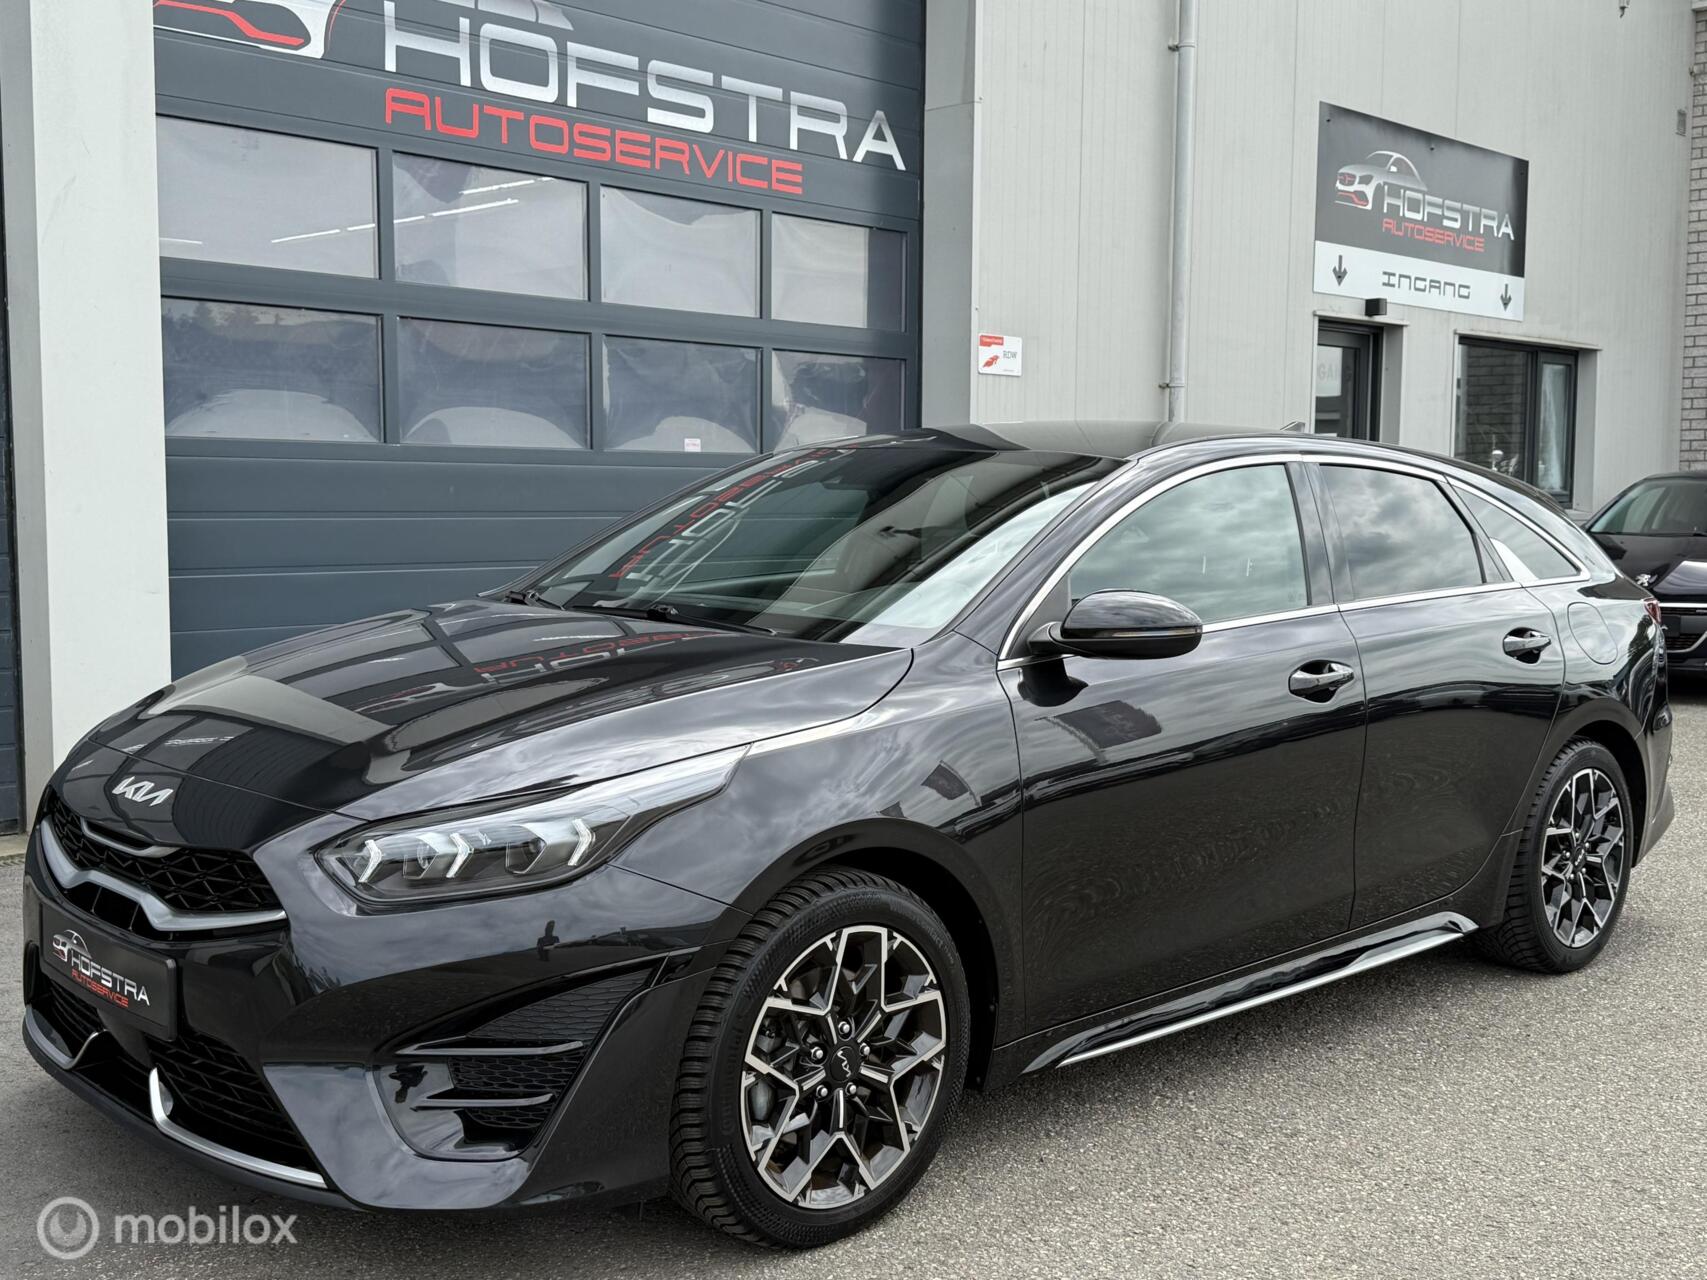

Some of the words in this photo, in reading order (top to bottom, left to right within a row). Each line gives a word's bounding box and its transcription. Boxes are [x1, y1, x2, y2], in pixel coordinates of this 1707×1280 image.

[384, 1, 906, 171] HOFSTRA
[385, 88, 803, 194] AUTOSERVICE
[1382, 218, 1485, 252] AUTOSERVICE
[1383, 184, 1514, 240] HOFSTRA
[1382, 271, 1471, 300] INGANG
[112, 776, 173, 807] KIA
[71, 953, 150, 1006] HOFSTRA
[71, 967, 129, 1008] AUTOSERVICE
